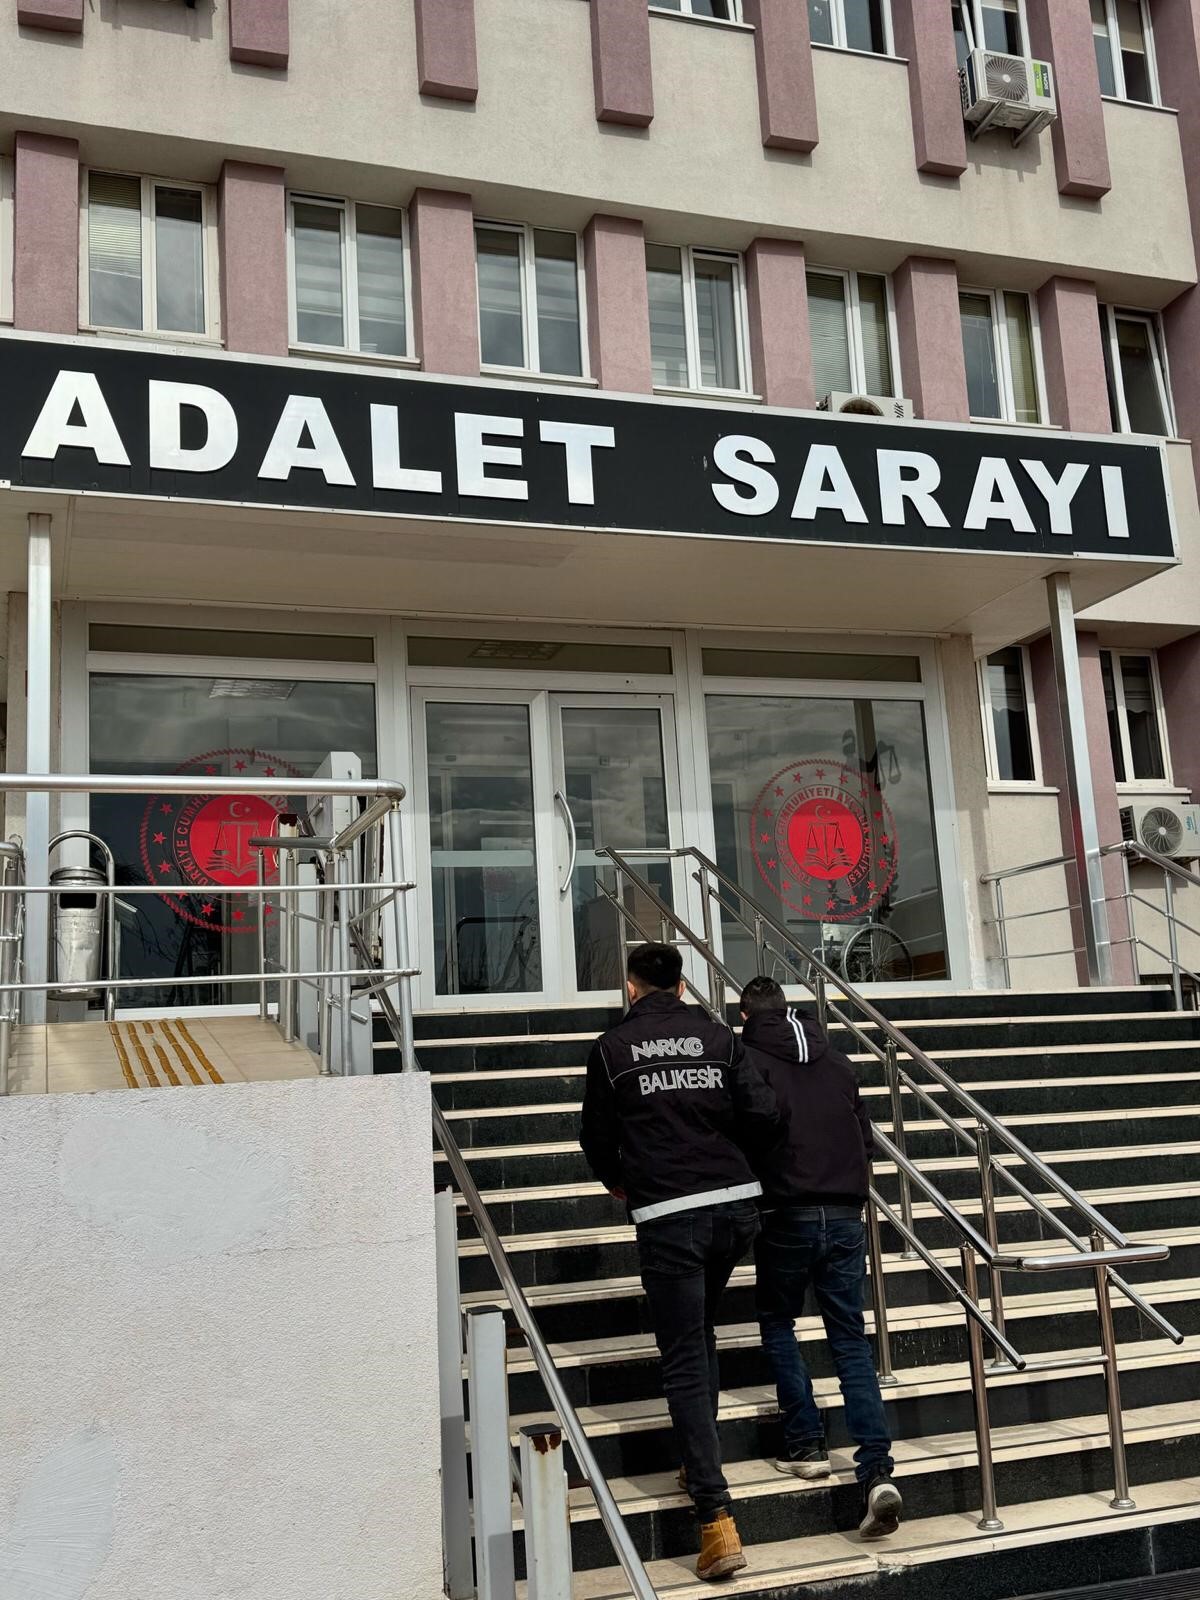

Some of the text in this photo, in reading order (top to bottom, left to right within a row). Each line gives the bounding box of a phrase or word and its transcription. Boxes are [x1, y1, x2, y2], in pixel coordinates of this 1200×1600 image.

[21, 370, 1129, 538] ADALET SARAYI
[176, 839, 216, 886] ÜRKİYE
[638, 1065, 724, 1095] BALIKESİR
